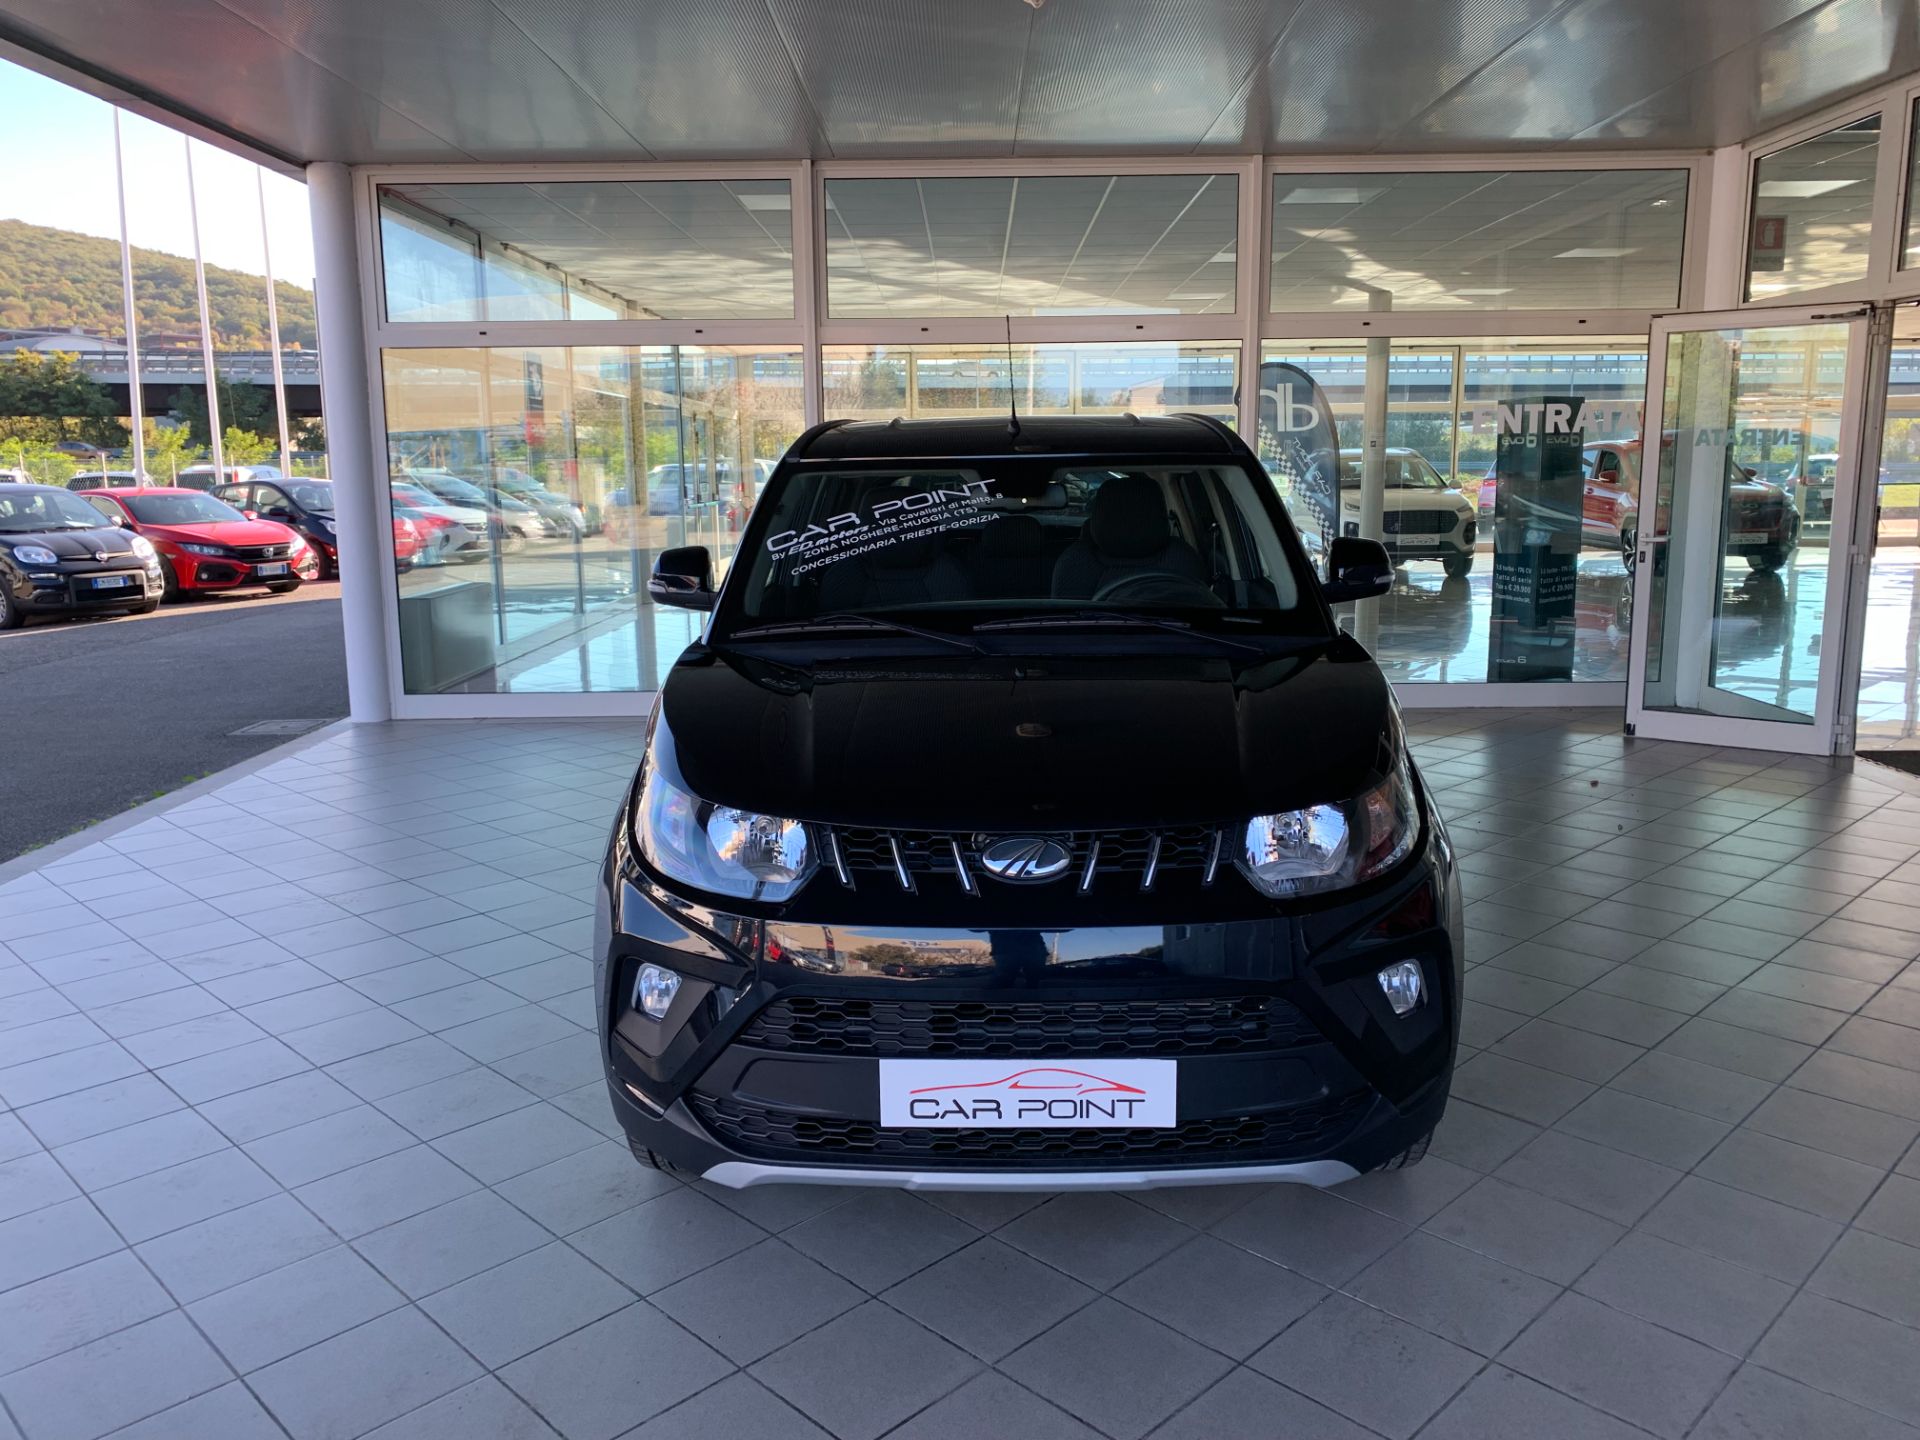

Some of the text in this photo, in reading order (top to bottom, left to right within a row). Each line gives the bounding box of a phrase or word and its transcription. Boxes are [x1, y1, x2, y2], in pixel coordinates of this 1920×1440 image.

[1473, 402, 1641, 434] ENTRATA
[767, 479, 996, 552] CAR POINT
[771, 552, 785, 561] By
[878, 518, 897, 527] Via
[899, 505, 946, 521] Cavalieri
[948, 502, 959, 510] di
[803, 505, 979, 558] ZONA NOGHERE-MUGGIA (TS)
[791, 513, 1000, 576] CONCESSIONARIA TRIESTE-GORIZIA
[1517, 655, 1527, 664] 6
[910, 1099, 1146, 1119] CAR POINT
